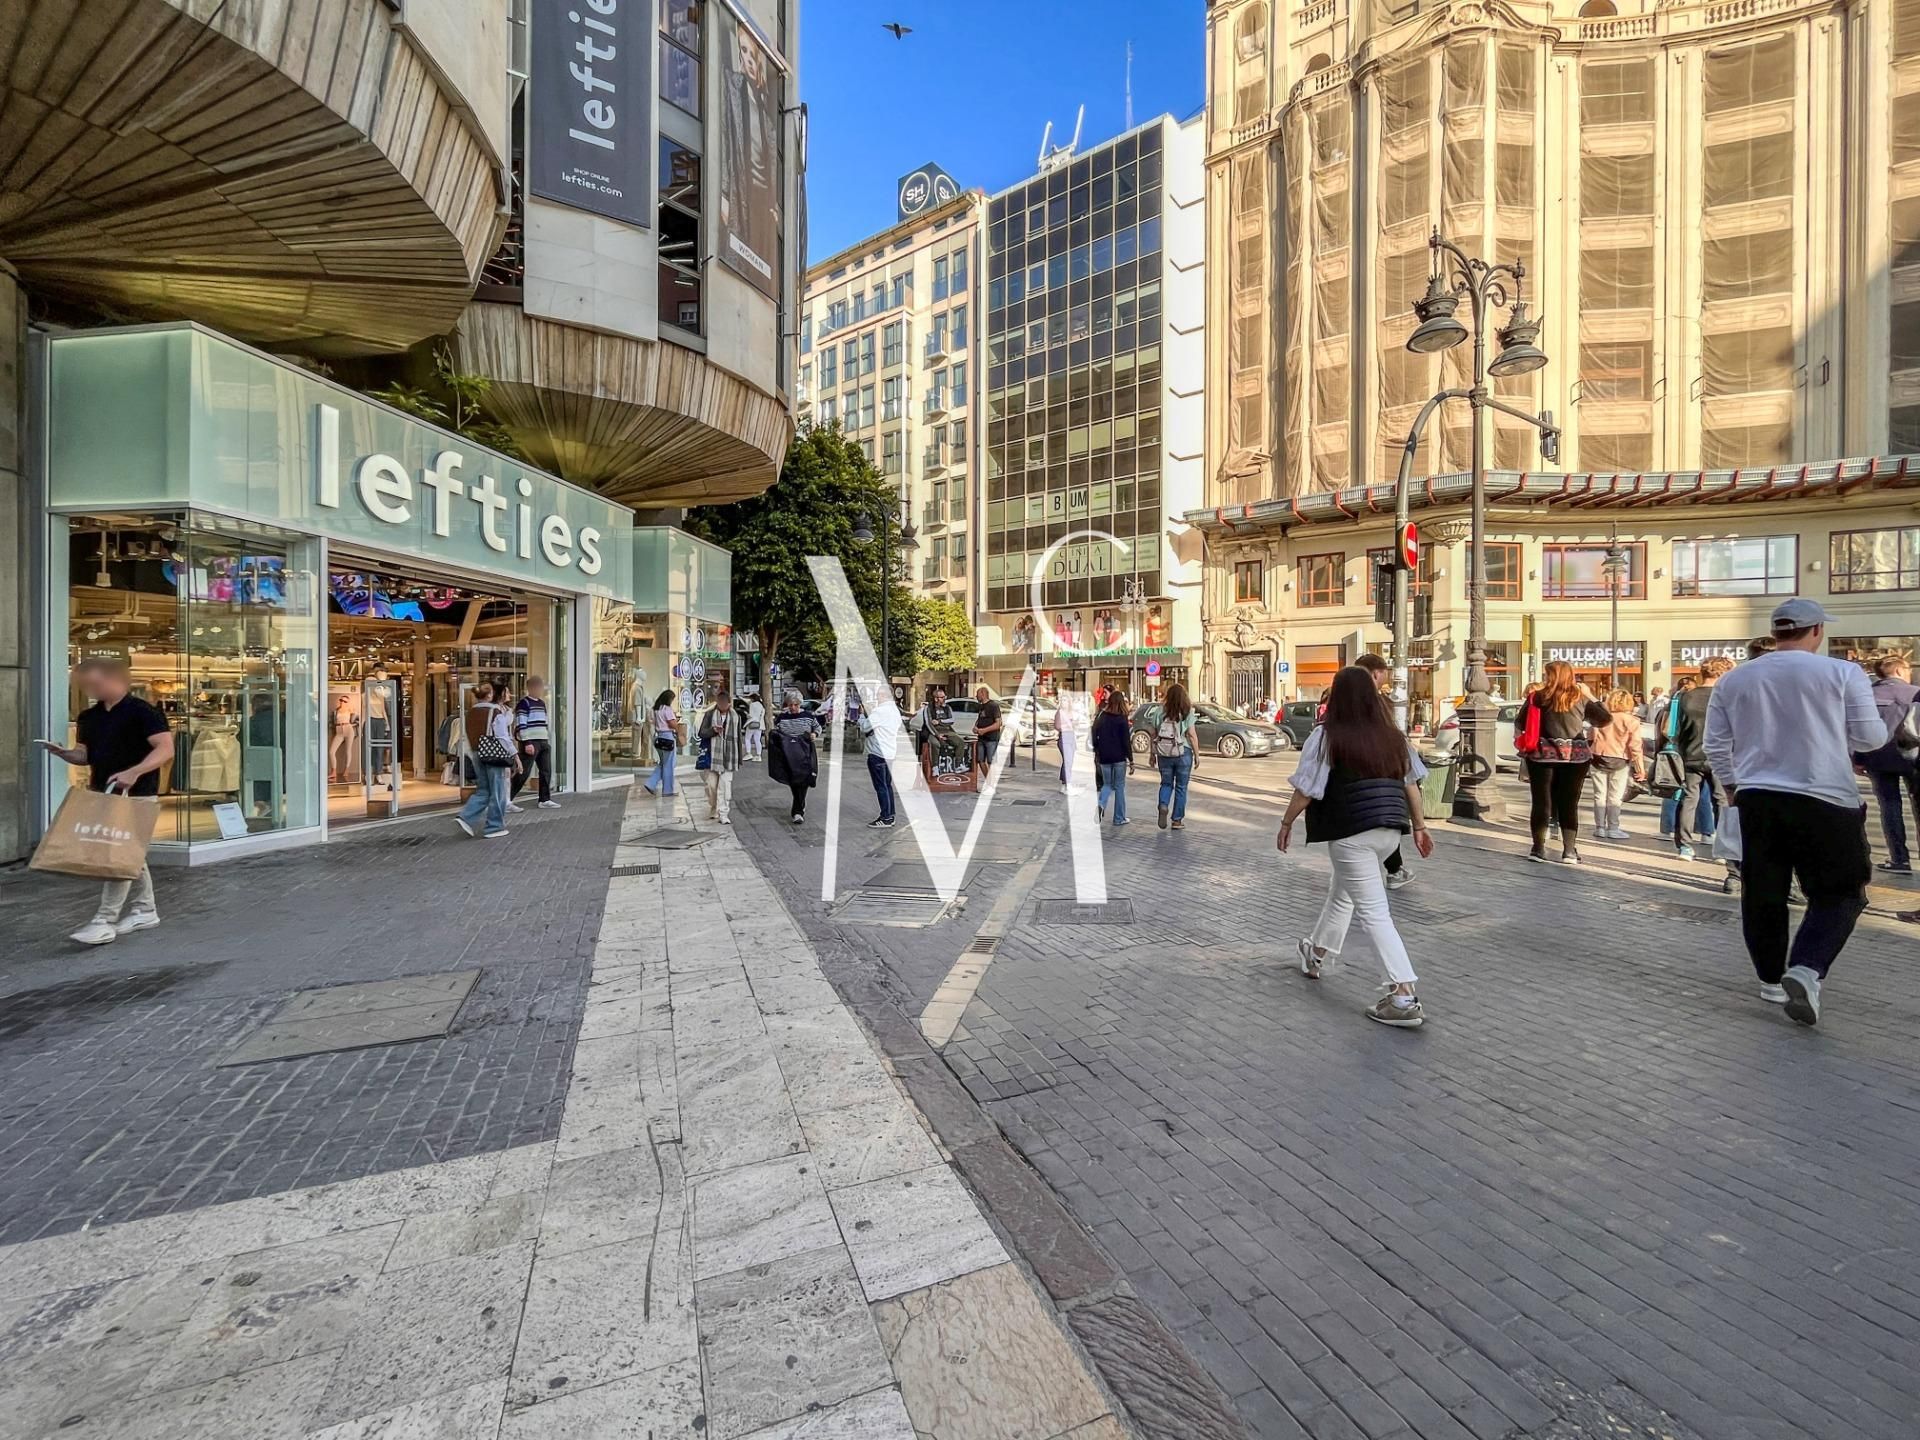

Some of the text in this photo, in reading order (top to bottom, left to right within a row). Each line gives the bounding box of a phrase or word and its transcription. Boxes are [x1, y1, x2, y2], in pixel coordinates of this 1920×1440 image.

[562, 171, 624, 198] lefties.com
[737, 242, 764, 270] WOMAN
[315, 403, 602, 576] lefties
[88, 648, 121, 656] lefties
[1549, 647, 1636, 662] PULL&BEAR
[74, 821, 131, 840] lefties
